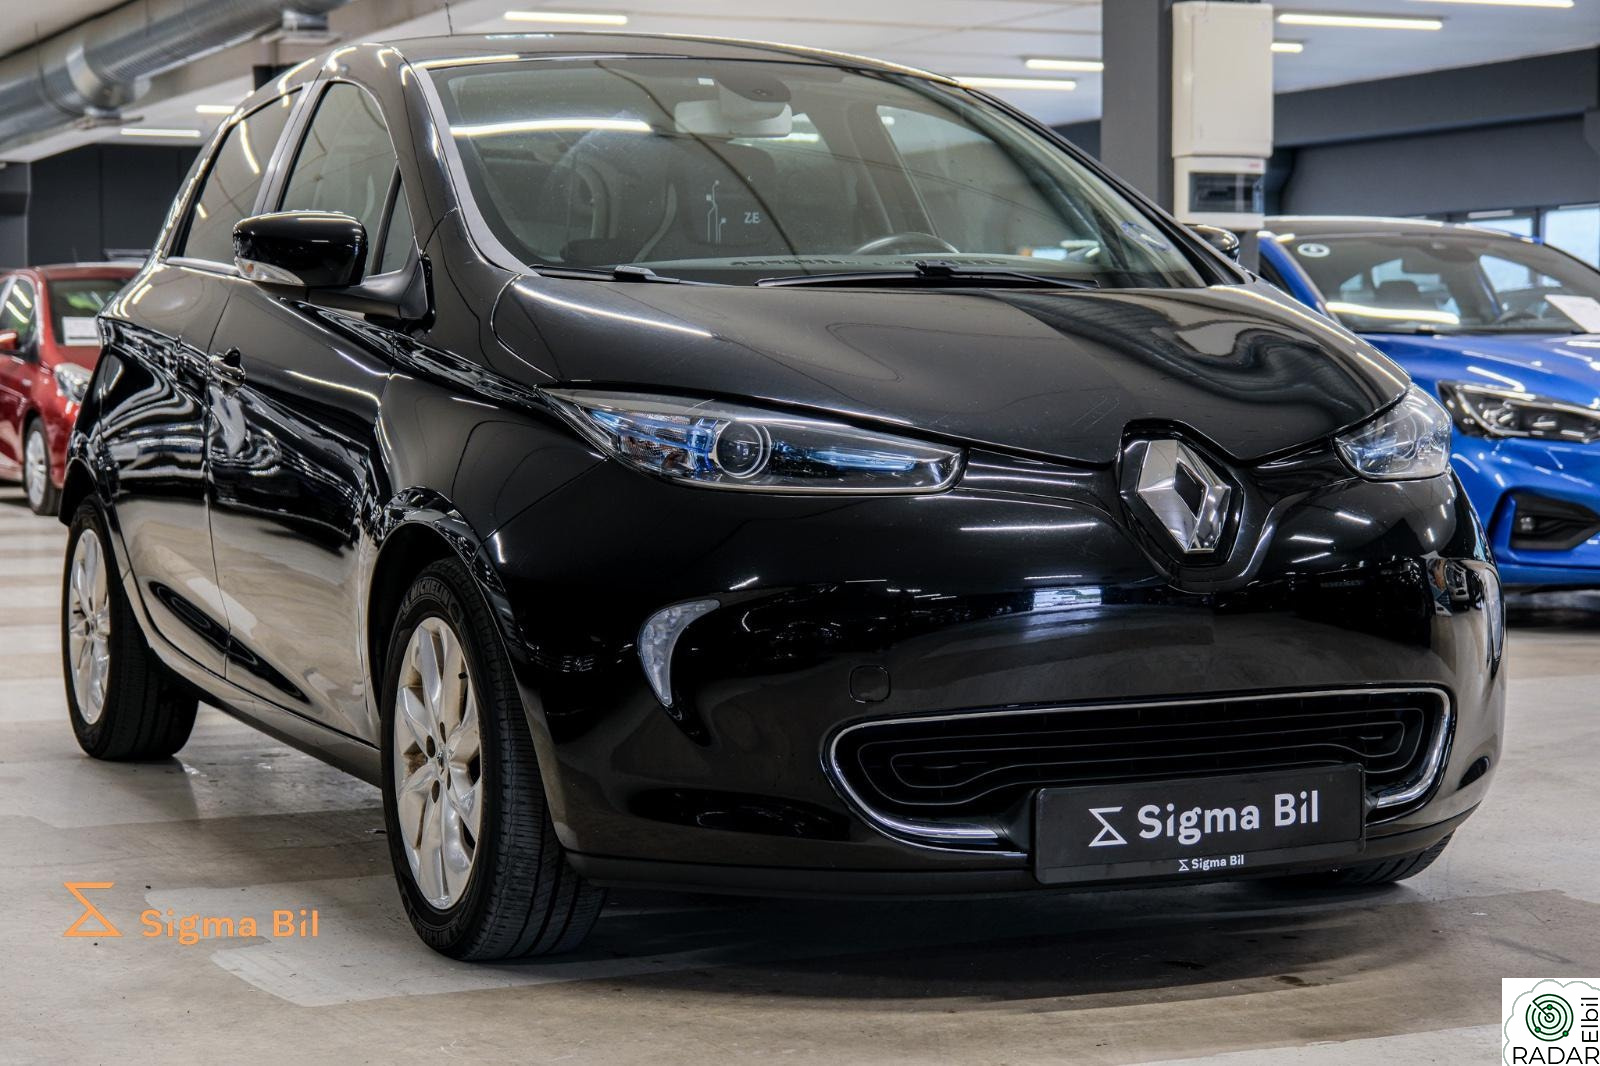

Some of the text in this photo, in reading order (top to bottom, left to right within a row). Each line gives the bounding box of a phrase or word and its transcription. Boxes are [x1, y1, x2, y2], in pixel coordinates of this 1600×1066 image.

[410, 579, 450, 607] MICHELIN
[1137, 790, 1319, 845] Sigma Bil
[1191, 854, 1244, 871] Sigma Bil
